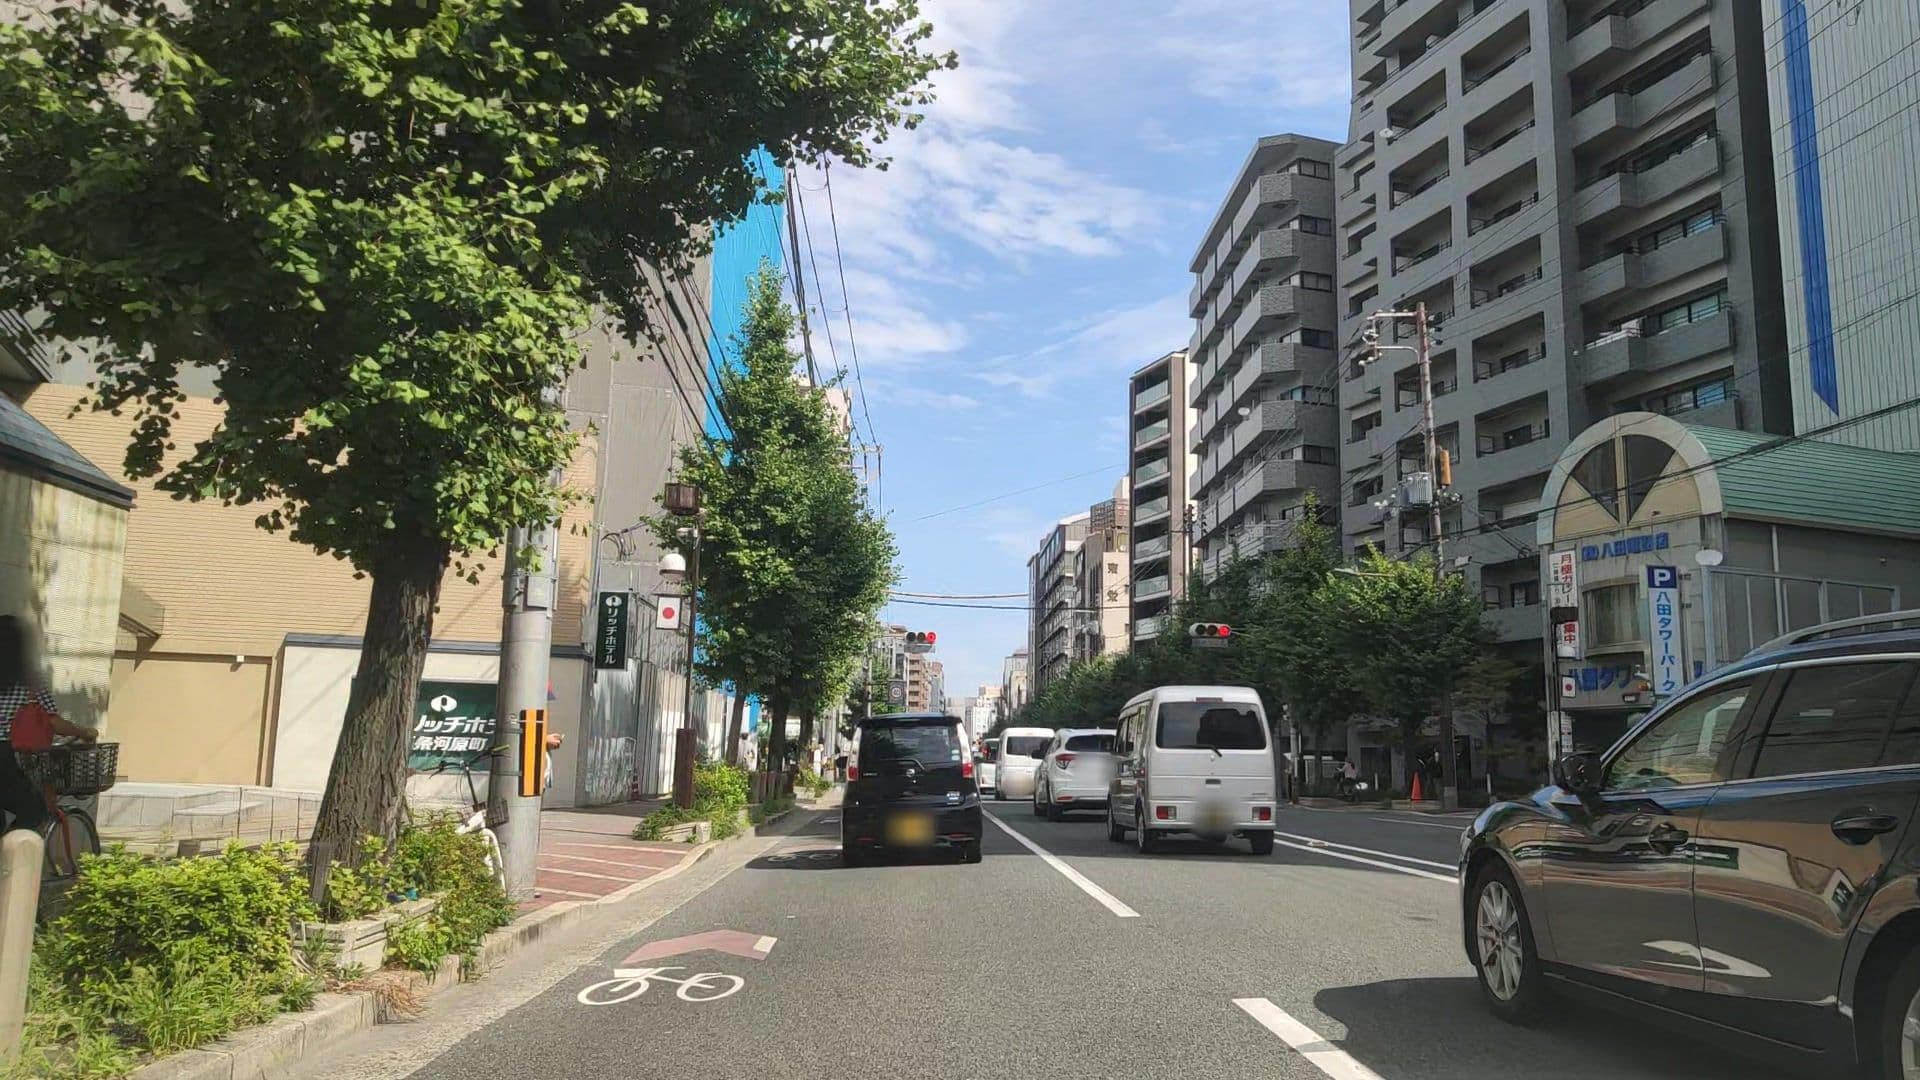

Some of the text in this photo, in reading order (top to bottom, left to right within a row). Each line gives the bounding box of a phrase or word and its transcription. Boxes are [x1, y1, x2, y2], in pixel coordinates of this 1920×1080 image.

[1653, 568, 1671, 587] P
[605, 607, 618, 665] リッチホテル
[1656, 591, 1676, 692] 八田タワーパーク
[412, 735, 489, 752] 条河原町
